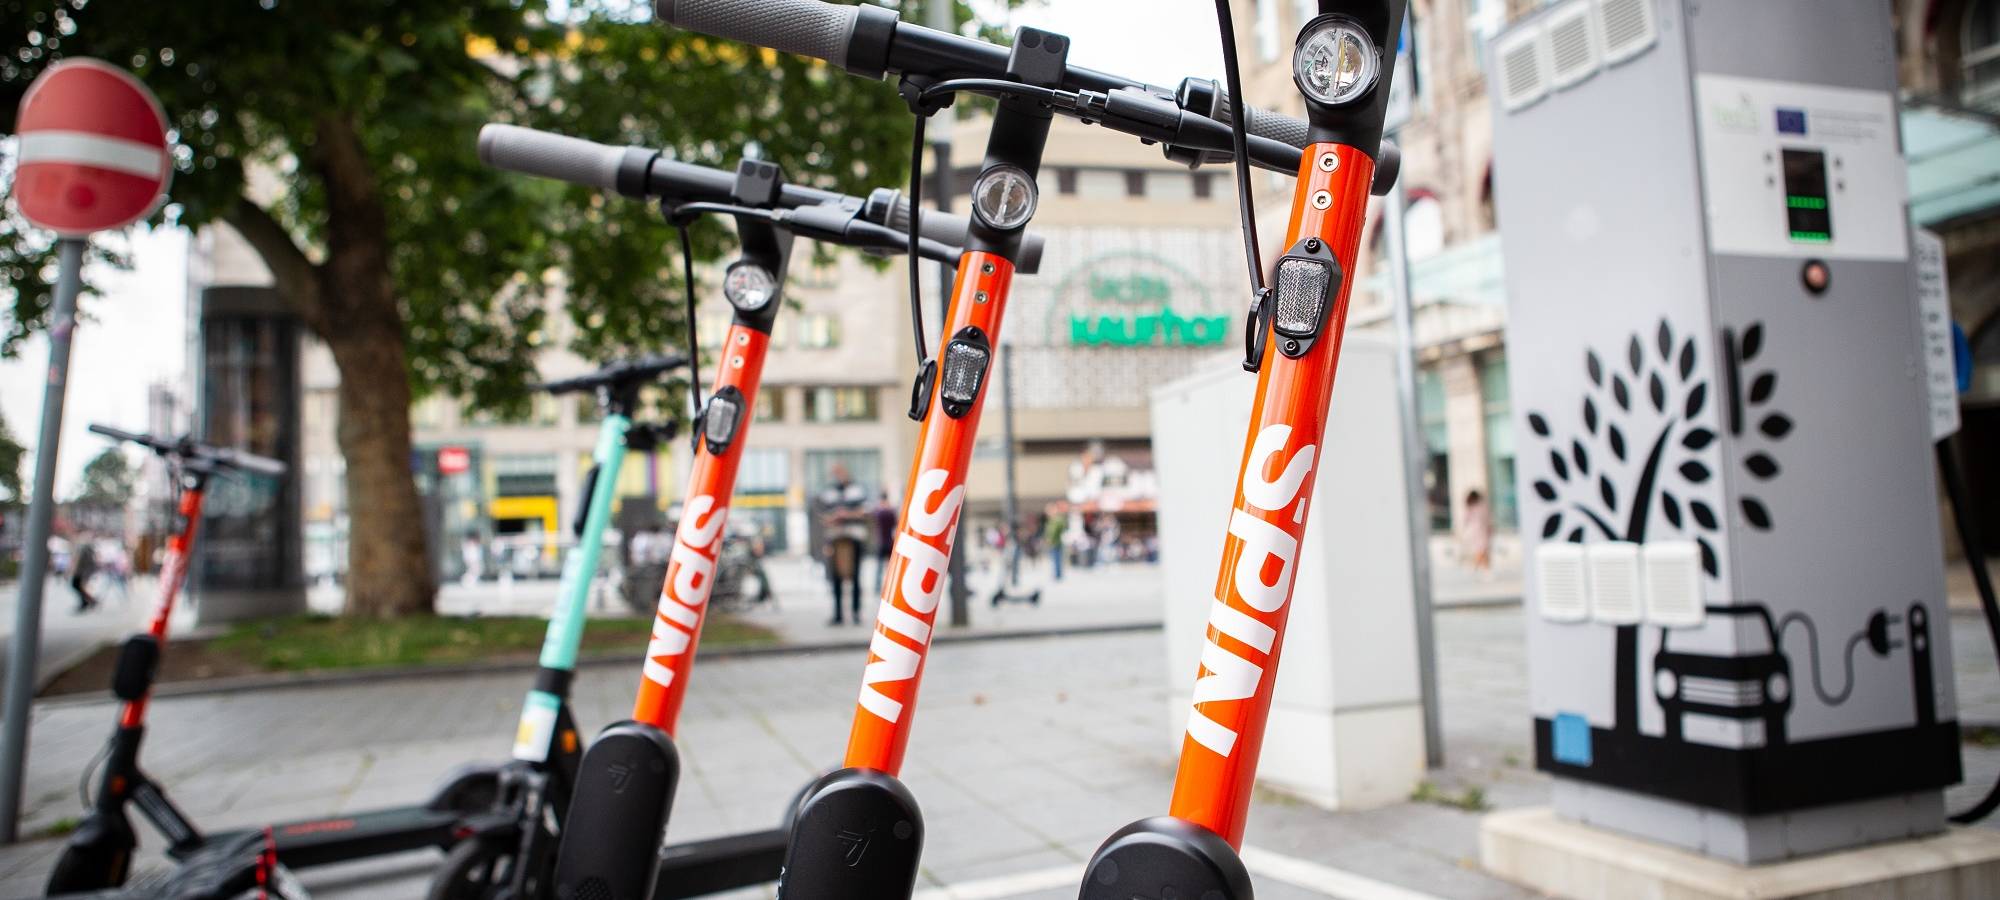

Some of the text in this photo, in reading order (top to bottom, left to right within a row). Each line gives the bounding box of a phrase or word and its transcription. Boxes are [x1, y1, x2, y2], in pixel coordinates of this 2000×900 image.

[643, 494, 727, 688] SPIN
[858, 468, 964, 724] SPIN
[1186, 424, 1316, 758] SPIN
